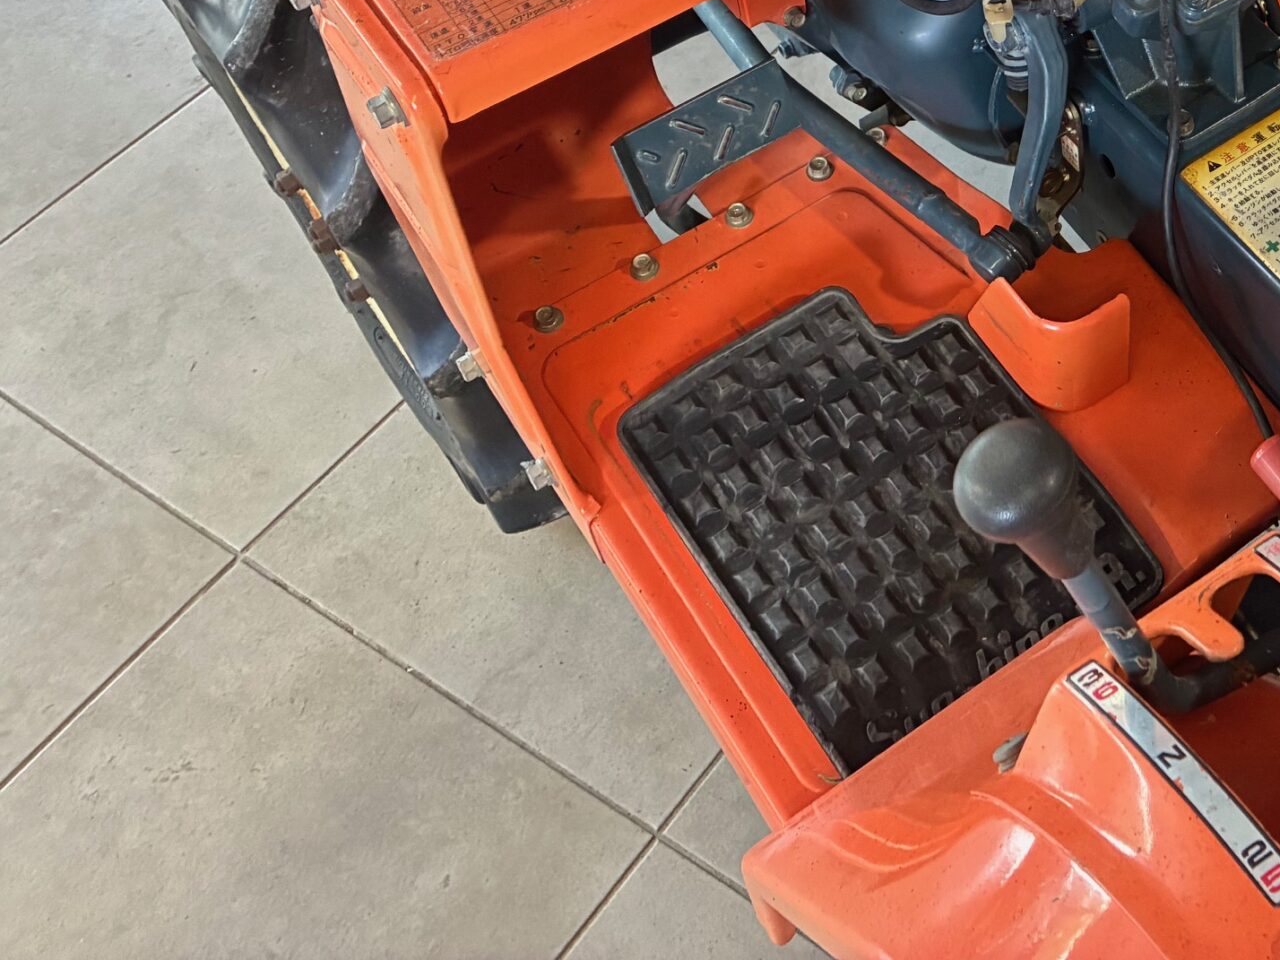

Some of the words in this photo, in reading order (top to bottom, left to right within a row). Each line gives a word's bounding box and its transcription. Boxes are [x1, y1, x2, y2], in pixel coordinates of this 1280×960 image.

[1095, 553, 1147, 595] R.
[1078, 669, 1102, 687] 3
[1092, 682, 1119, 701] 6
[1157, 744, 1187, 769] N
[1241, 840, 1273, 869] 2
